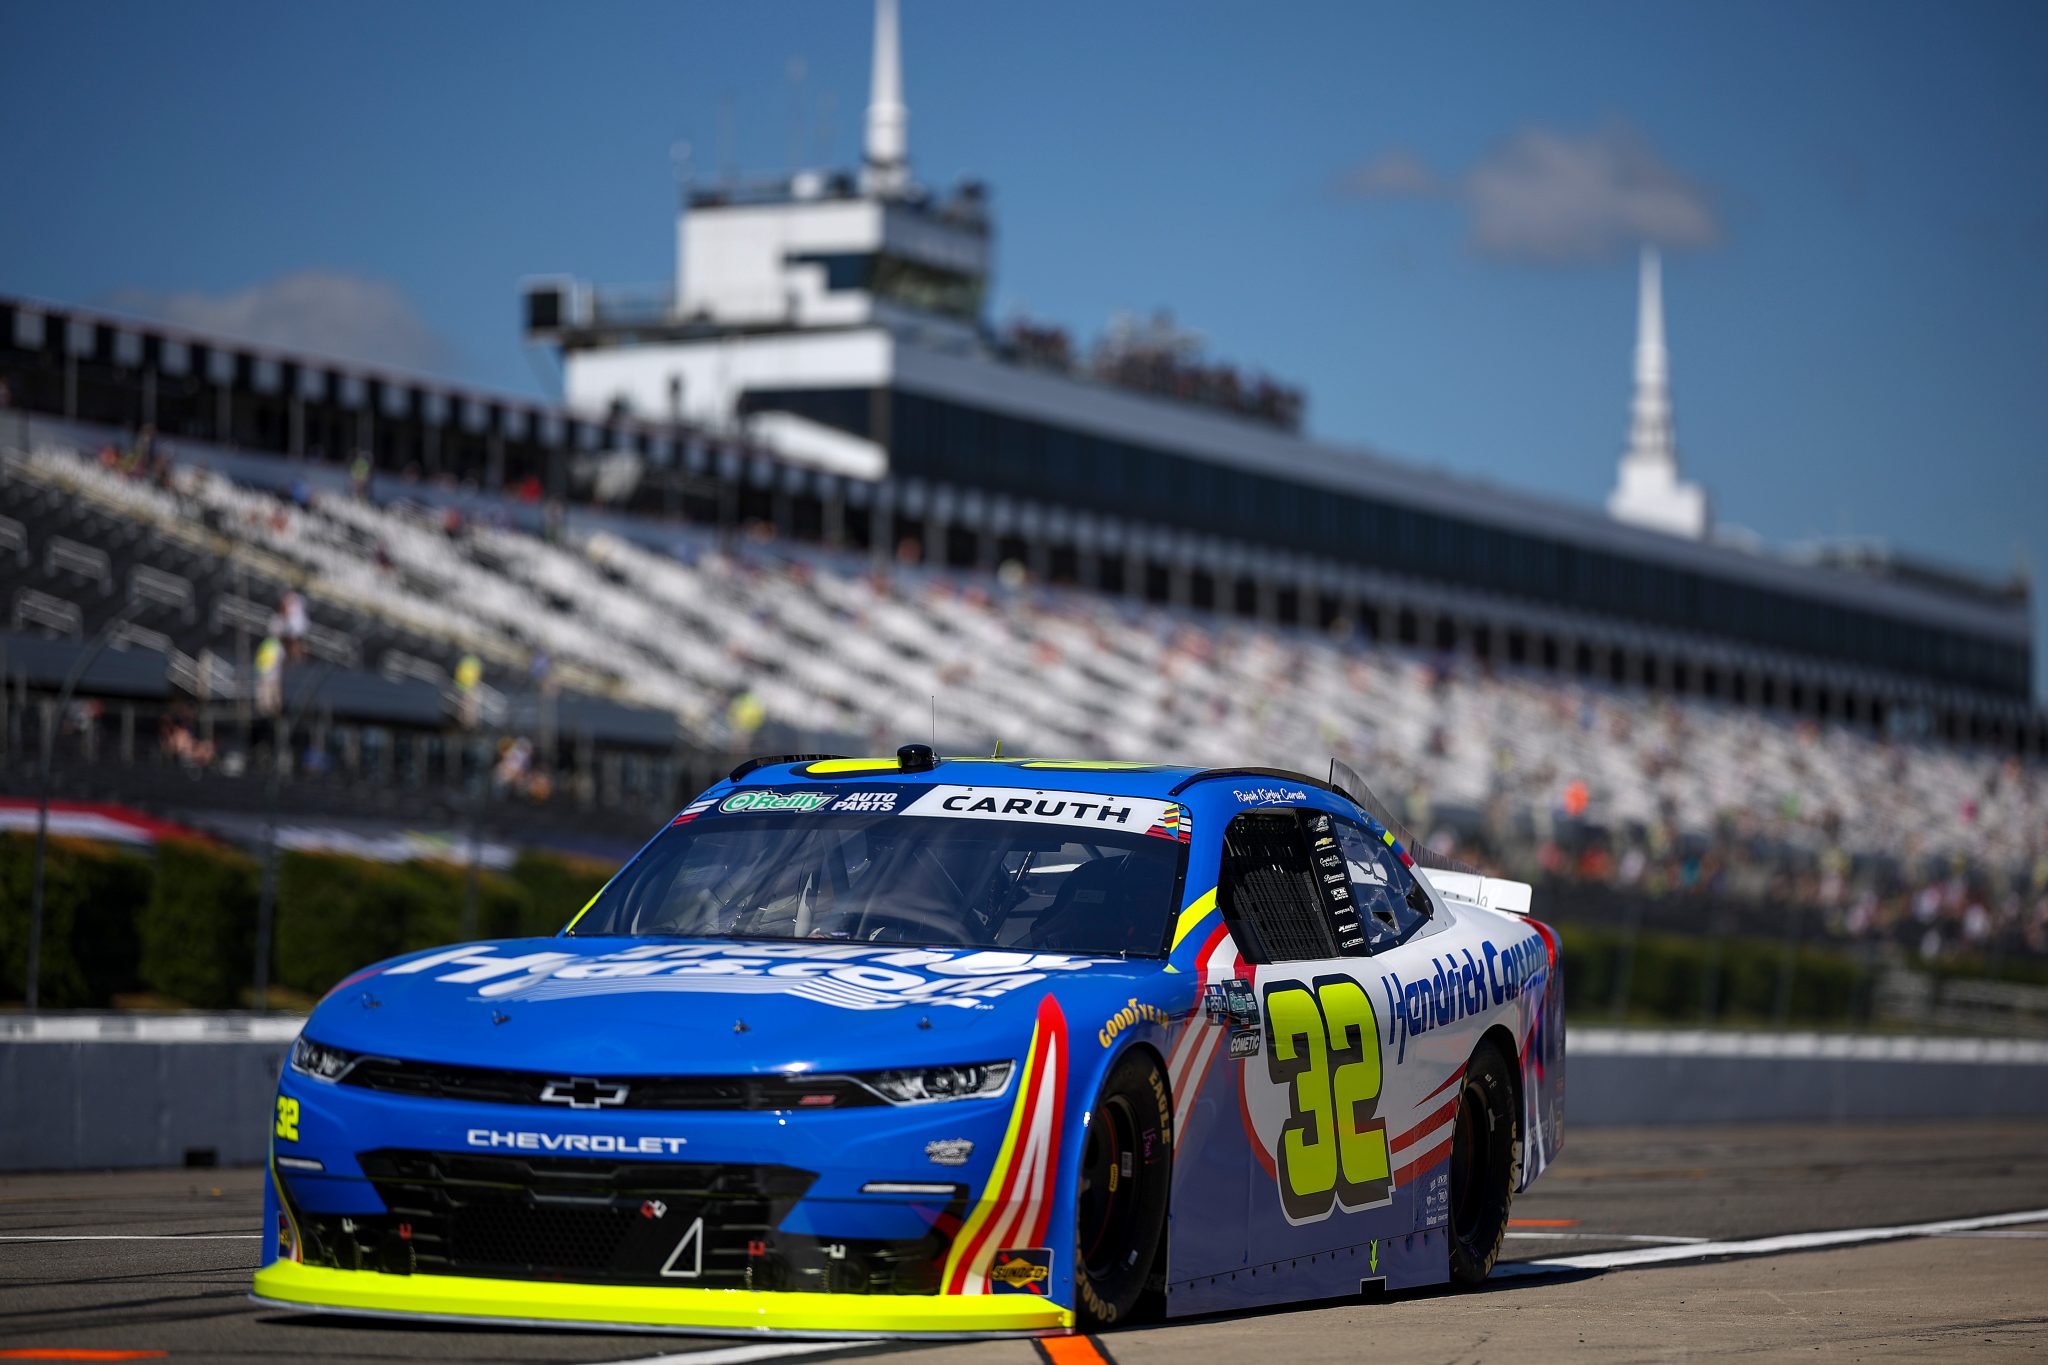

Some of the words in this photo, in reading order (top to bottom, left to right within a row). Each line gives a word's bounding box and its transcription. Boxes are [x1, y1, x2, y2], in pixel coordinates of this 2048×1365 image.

[723, 790, 832, 813] O'Reilly
[831, 801, 896, 811] PARTS
[845, 792, 898, 802] AUTO
[942, 795, 1131, 823] CARUTH
[1230, 1035, 1260, 1053] COMETIC
[1266, 979, 1390, 1198] 32
[276, 1095, 300, 1142] 32
[1148, 1067, 1171, 1145] EAGLE
[467, 1129, 687, 1154] CHEVROLET
